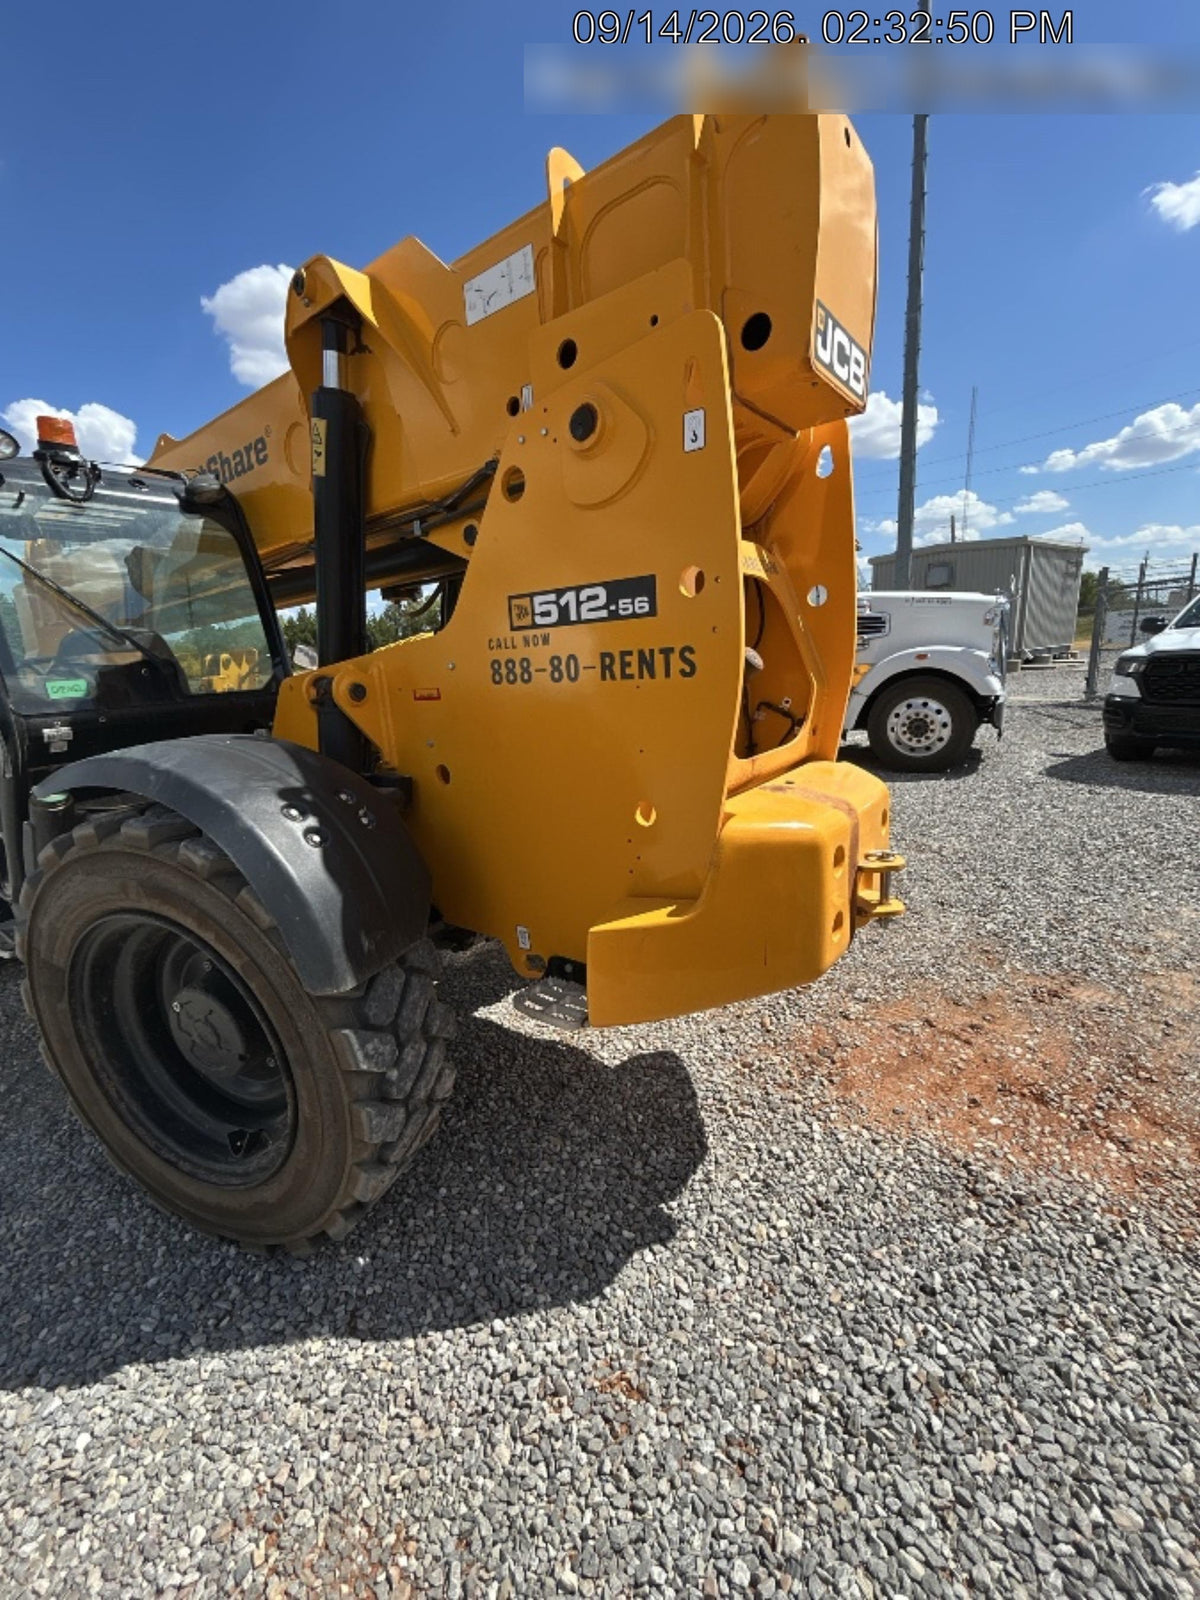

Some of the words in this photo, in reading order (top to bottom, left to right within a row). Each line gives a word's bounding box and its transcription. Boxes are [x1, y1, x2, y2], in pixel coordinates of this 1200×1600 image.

[816, 317, 865, 396] JCB
[532, 585, 650, 626] 512-56
[487, 636, 518, 651] CALL
[523, 632, 550, 648] NOW
[490, 645, 697, 685] 888-80-RENTS
